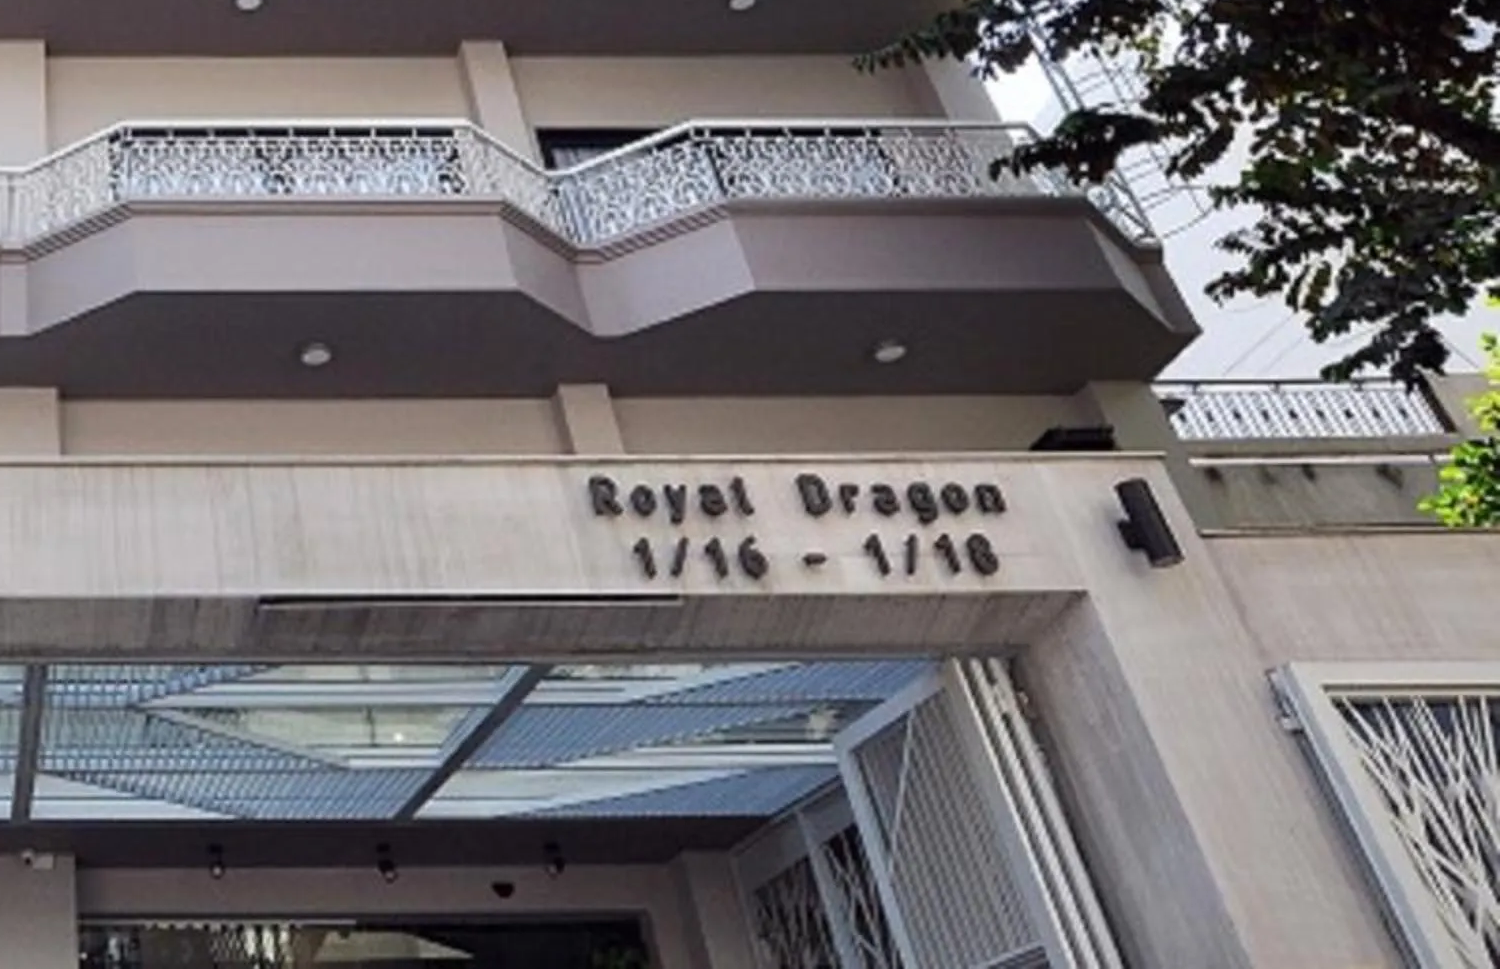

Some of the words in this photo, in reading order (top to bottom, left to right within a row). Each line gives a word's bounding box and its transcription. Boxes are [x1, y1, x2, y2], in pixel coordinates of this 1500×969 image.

[588, 475, 755, 524] Royal
[795, 474, 1007, 526] Dragon
[632, 535, 769, 581] 1/16
